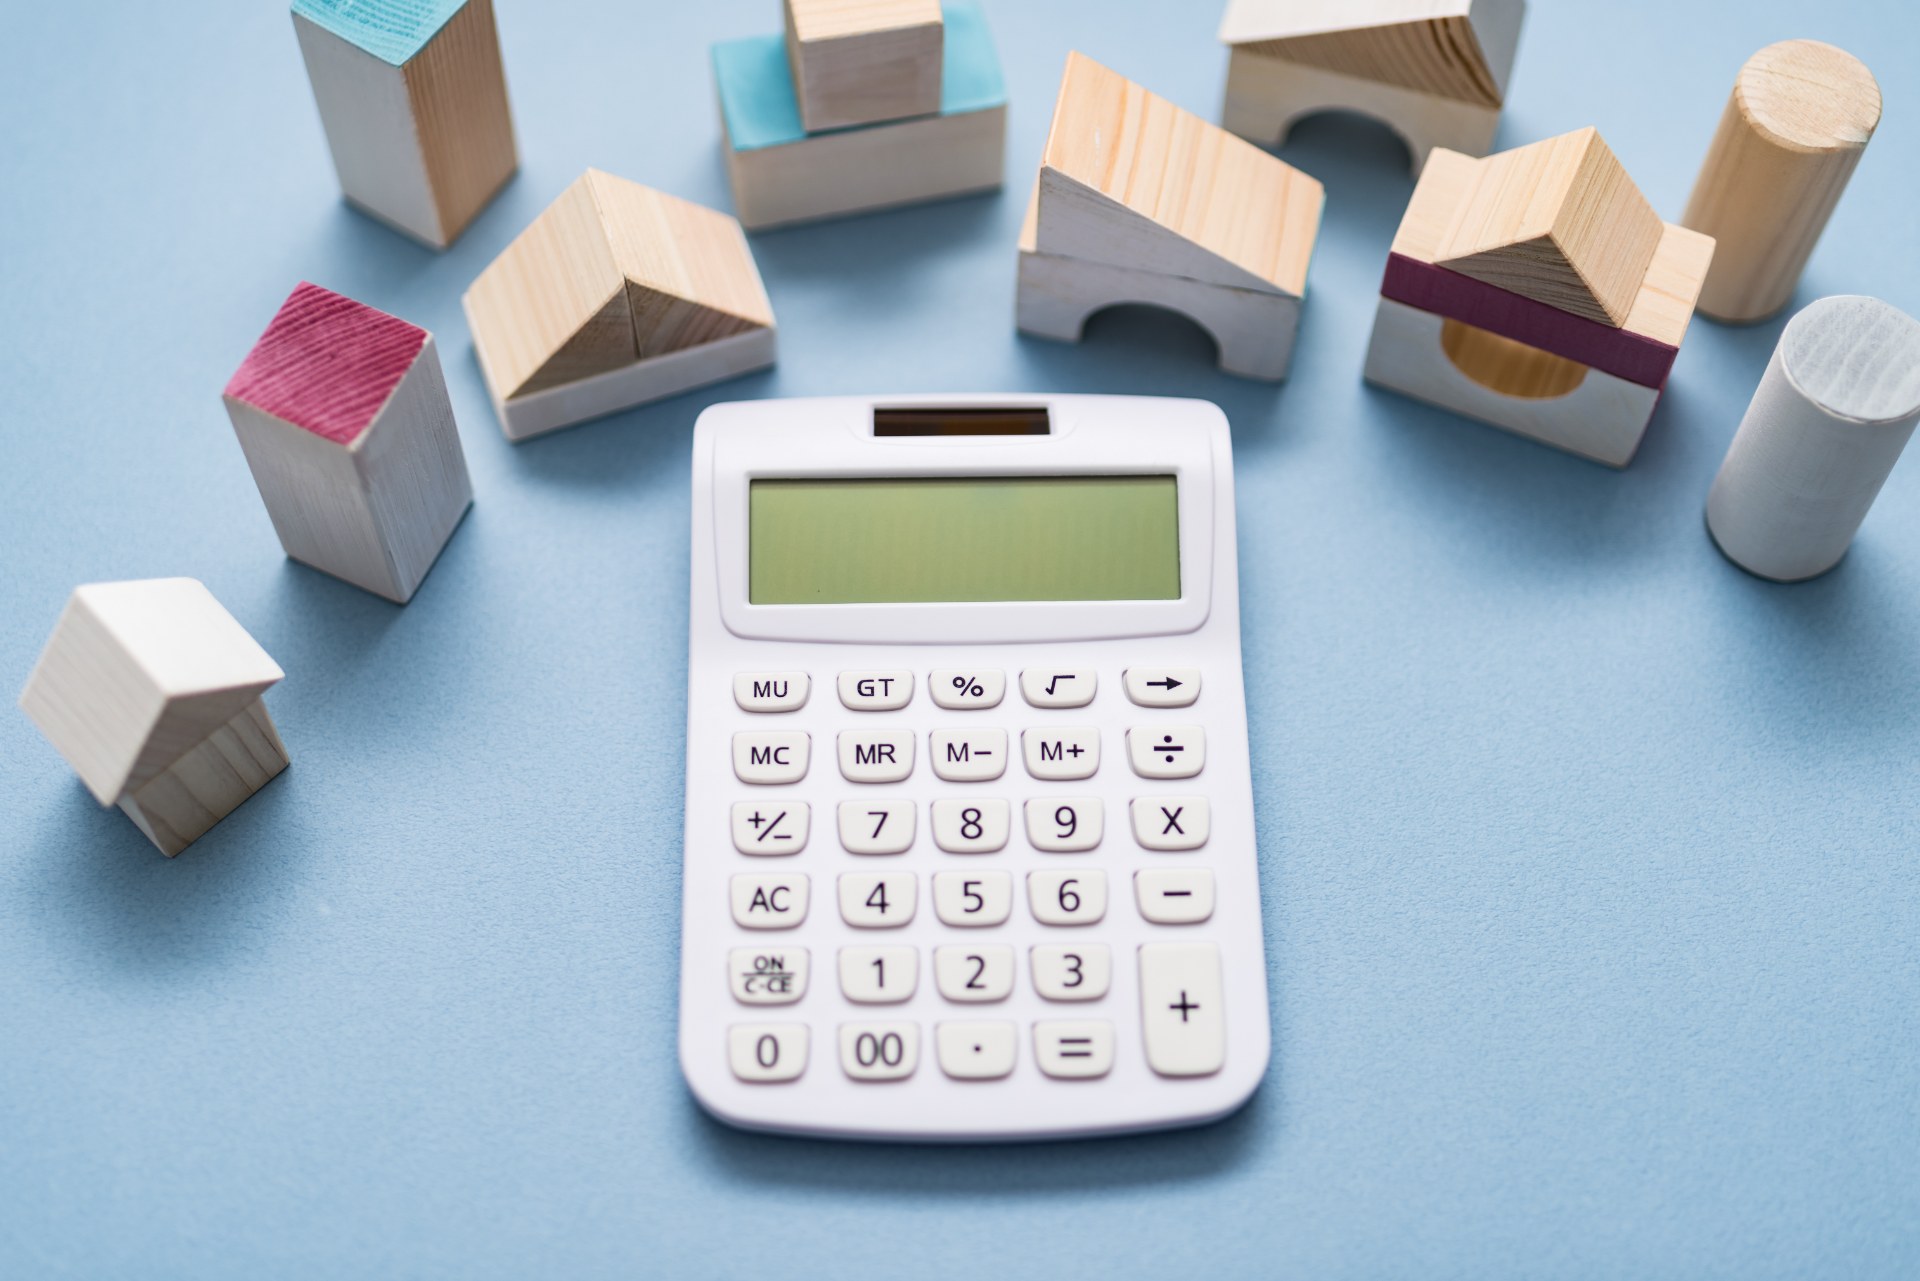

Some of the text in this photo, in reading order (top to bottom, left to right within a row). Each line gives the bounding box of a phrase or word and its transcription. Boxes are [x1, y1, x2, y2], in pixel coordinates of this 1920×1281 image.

[753, 680, 788, 698] MU
[857, 678, 894, 697] GT
[952, 676, 984, 697] %
[751, 745, 790, 765] MC
[855, 743, 897, 765] MR
[1040, 740, 1085, 761] M+
[867, 811, 889, 839] 7
[960, 807, 984, 840] 8
[1054, 805, 1077, 839] 9
[749, 886, 791, 913] AC
[865, 881, 890, 914] 4
[963, 881, 984, 914] 5
[1058, 879, 1081, 913] 6
[753, 955, 785, 971] ON
[870, 957, 884, 989] 1
[965, 955, 986, 989] 2
[1063, 954, 1084, 988] 3
[755, 1034, 780, 1068] 0
[855, 1031, 904, 1068] 00
